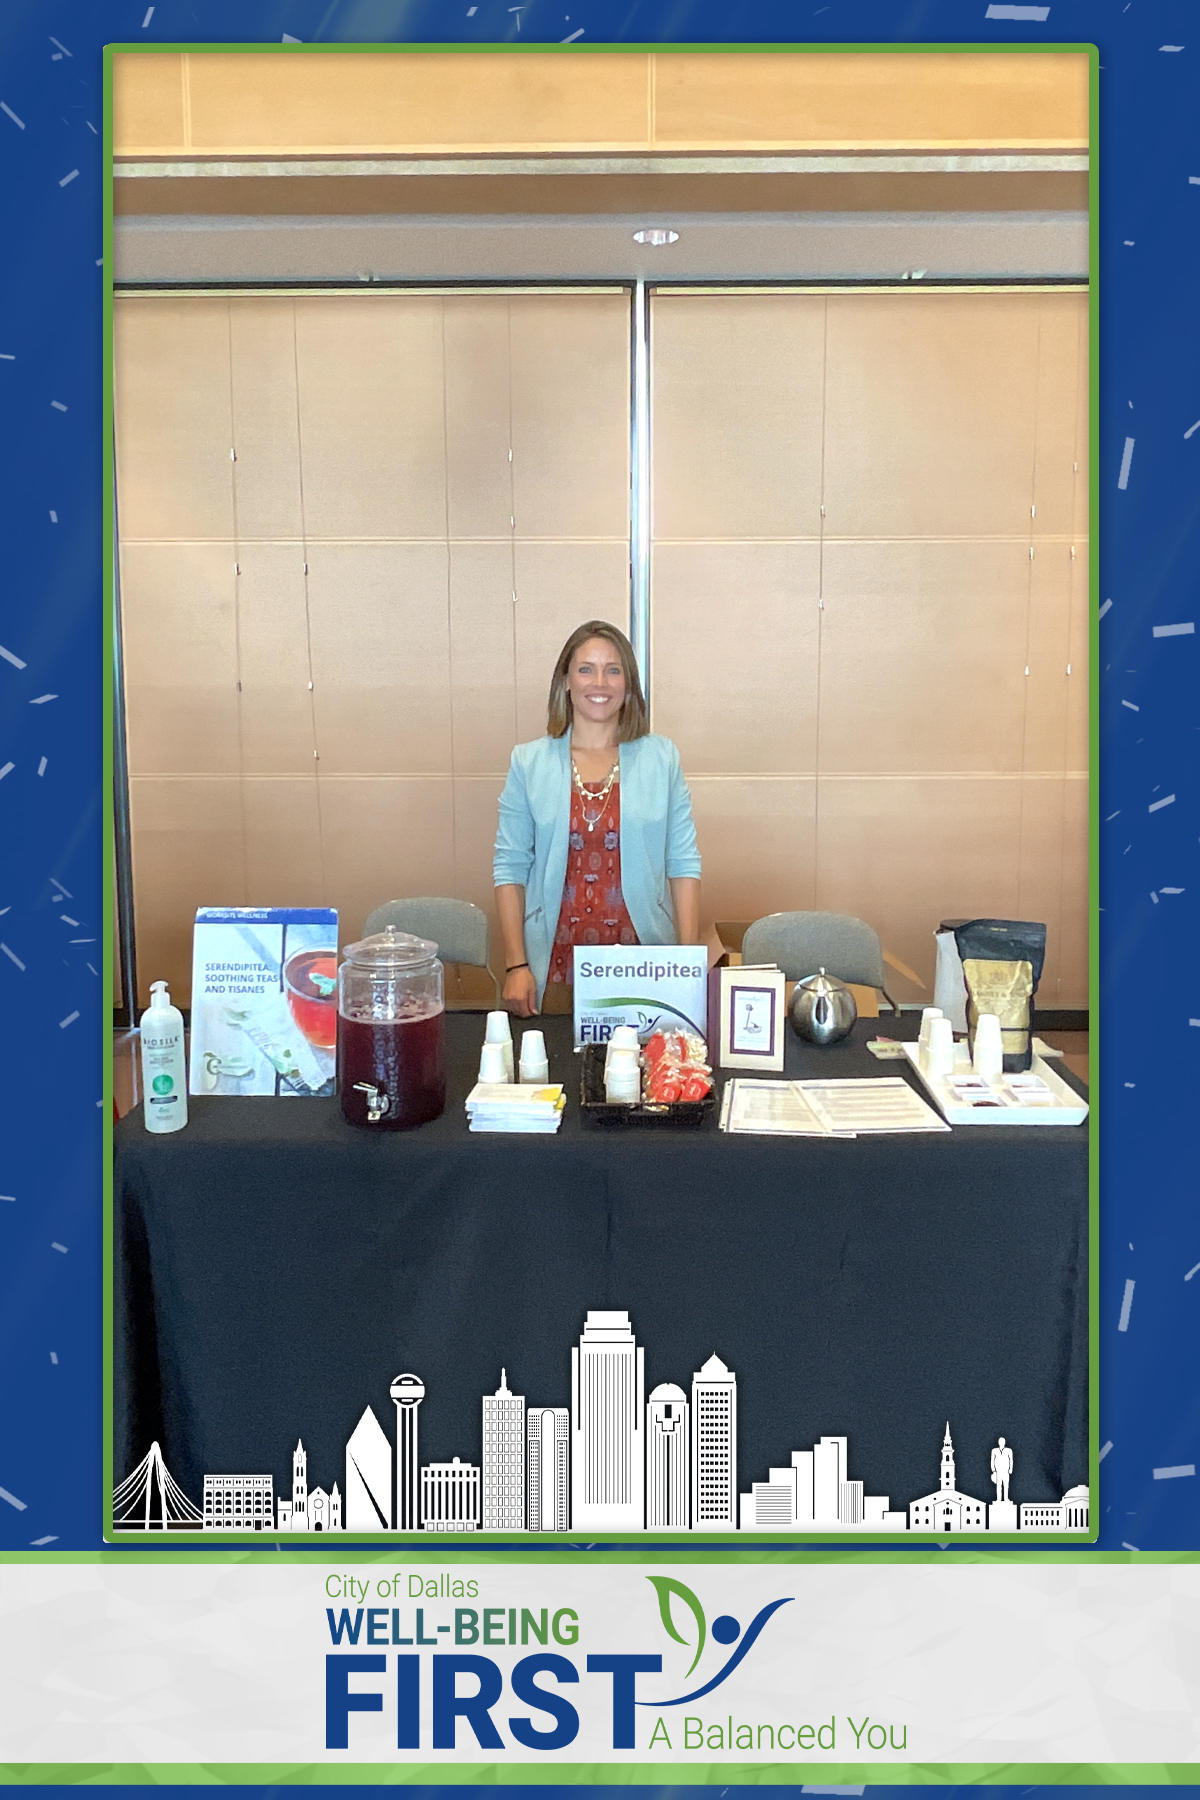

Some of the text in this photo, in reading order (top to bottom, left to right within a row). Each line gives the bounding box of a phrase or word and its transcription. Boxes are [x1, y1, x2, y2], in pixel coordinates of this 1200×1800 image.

[205, 962, 272, 972] SERENDIPITEA:
[580, 961, 702, 981] Serendipitea
[205, 973, 278, 983] SOOTHING TEAS
[204, 985, 265, 994] AND TISANES
[580, 1016, 626, 1025] WELL-BEING
[580, 1024, 640, 1042] FIR
